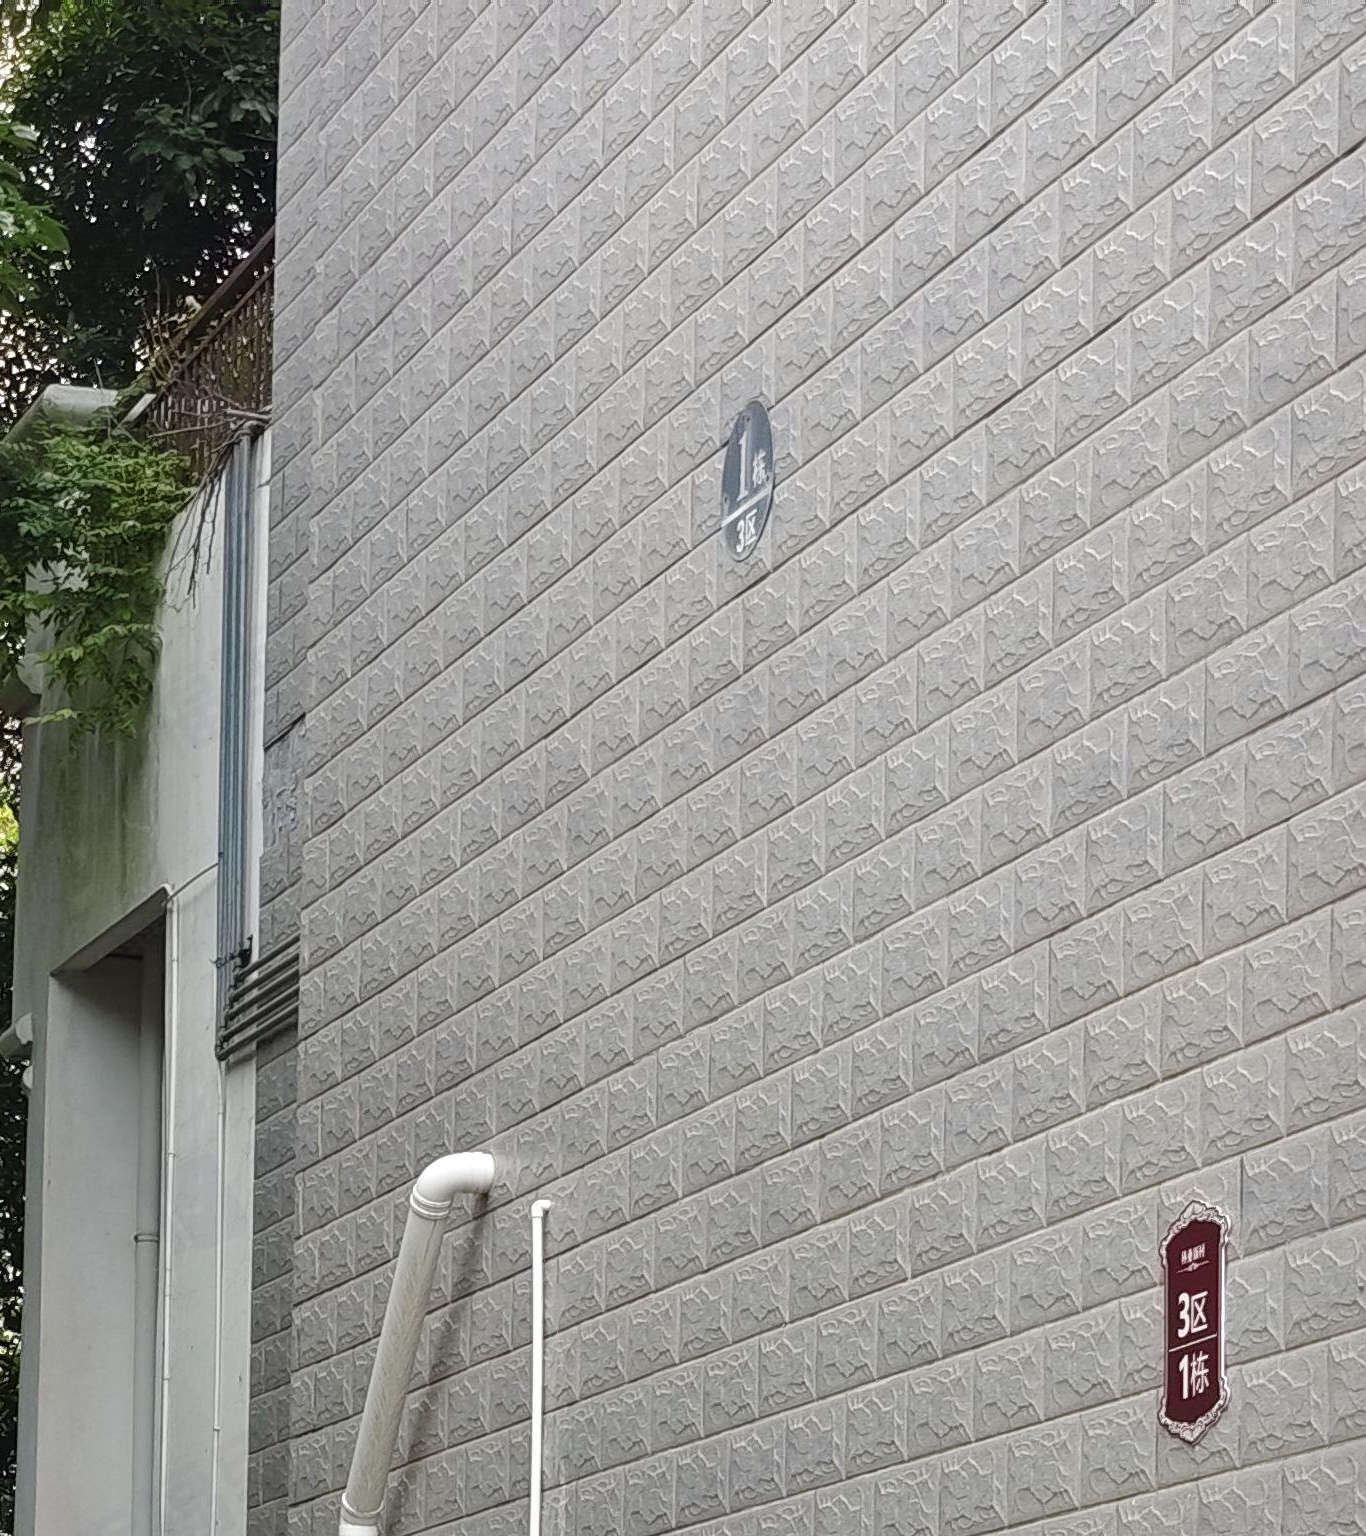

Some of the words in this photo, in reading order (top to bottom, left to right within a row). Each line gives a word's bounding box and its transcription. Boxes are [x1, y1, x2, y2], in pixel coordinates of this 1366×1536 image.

[736, 508, 758, 553] 3区
[1177, 1290, 1209, 1339] 3区
[1178, 1350, 1210, 1400] 1栋
